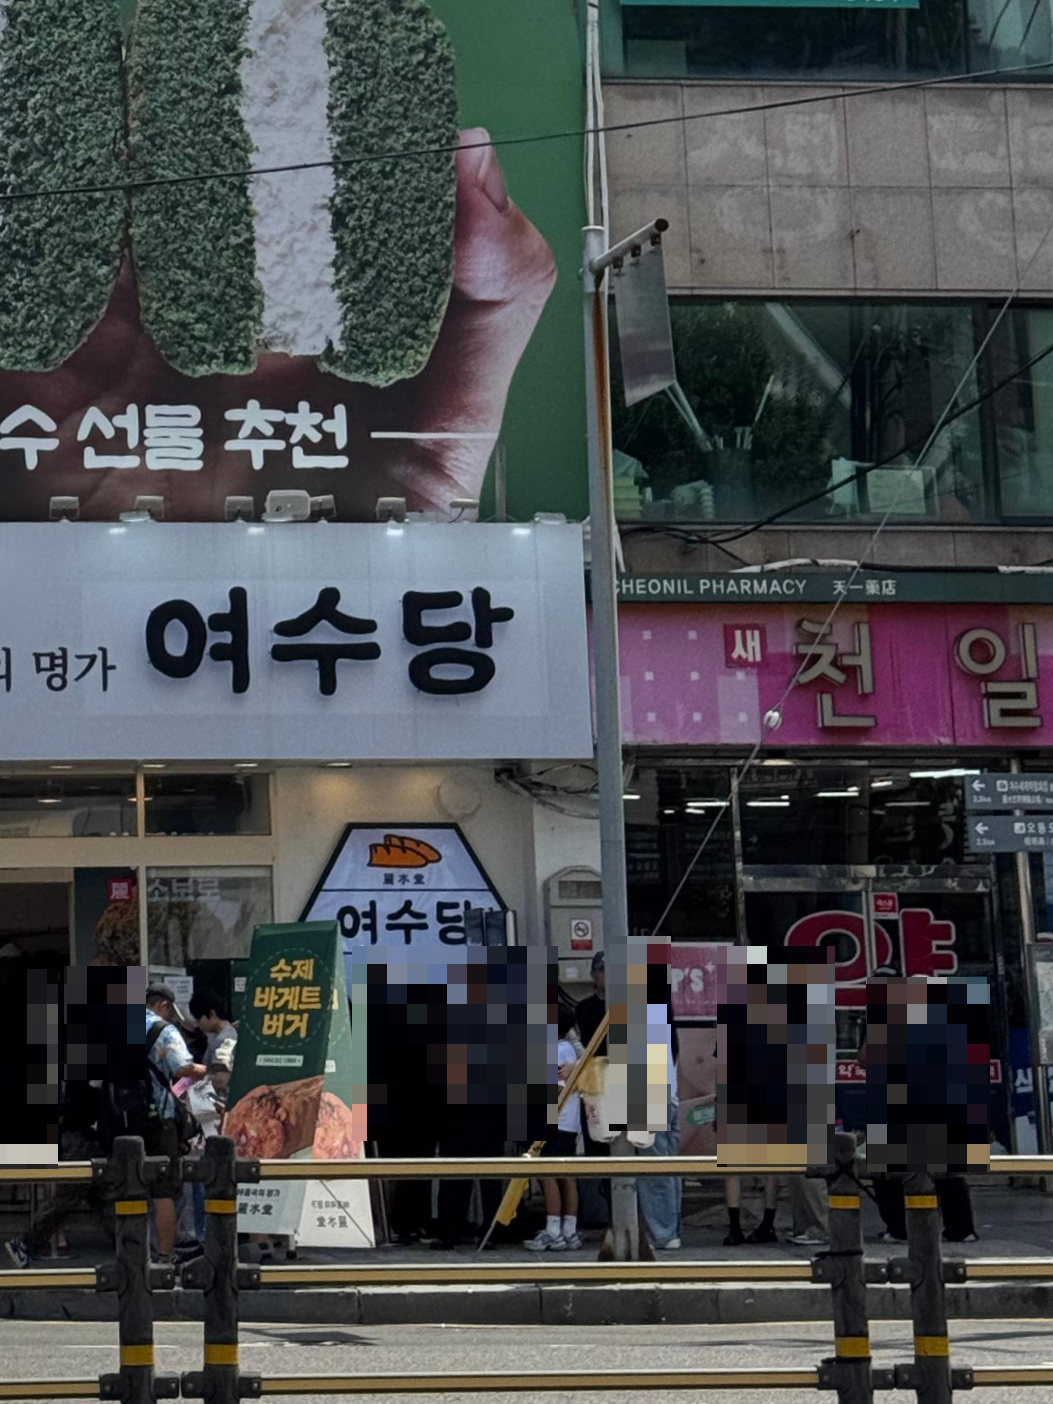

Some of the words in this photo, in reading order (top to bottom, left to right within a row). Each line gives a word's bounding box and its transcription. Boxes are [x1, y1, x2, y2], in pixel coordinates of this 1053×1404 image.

[77, 402, 205, 470] 선물
[224, 400, 349, 470] 추천
[699, 578, 807, 595] PHARMACY
[33, 647, 117, 694] 명가
[145, 586, 515, 696] 여수당
[731, 629, 762, 664] 새
[794, 617, 1044, 729] 천일
[337, 899, 471, 945] 여수당
[270, 958, 315, 982] 수제
[253, 986, 322, 1011] 바게트
[262, 1013, 309, 1039] 버거
